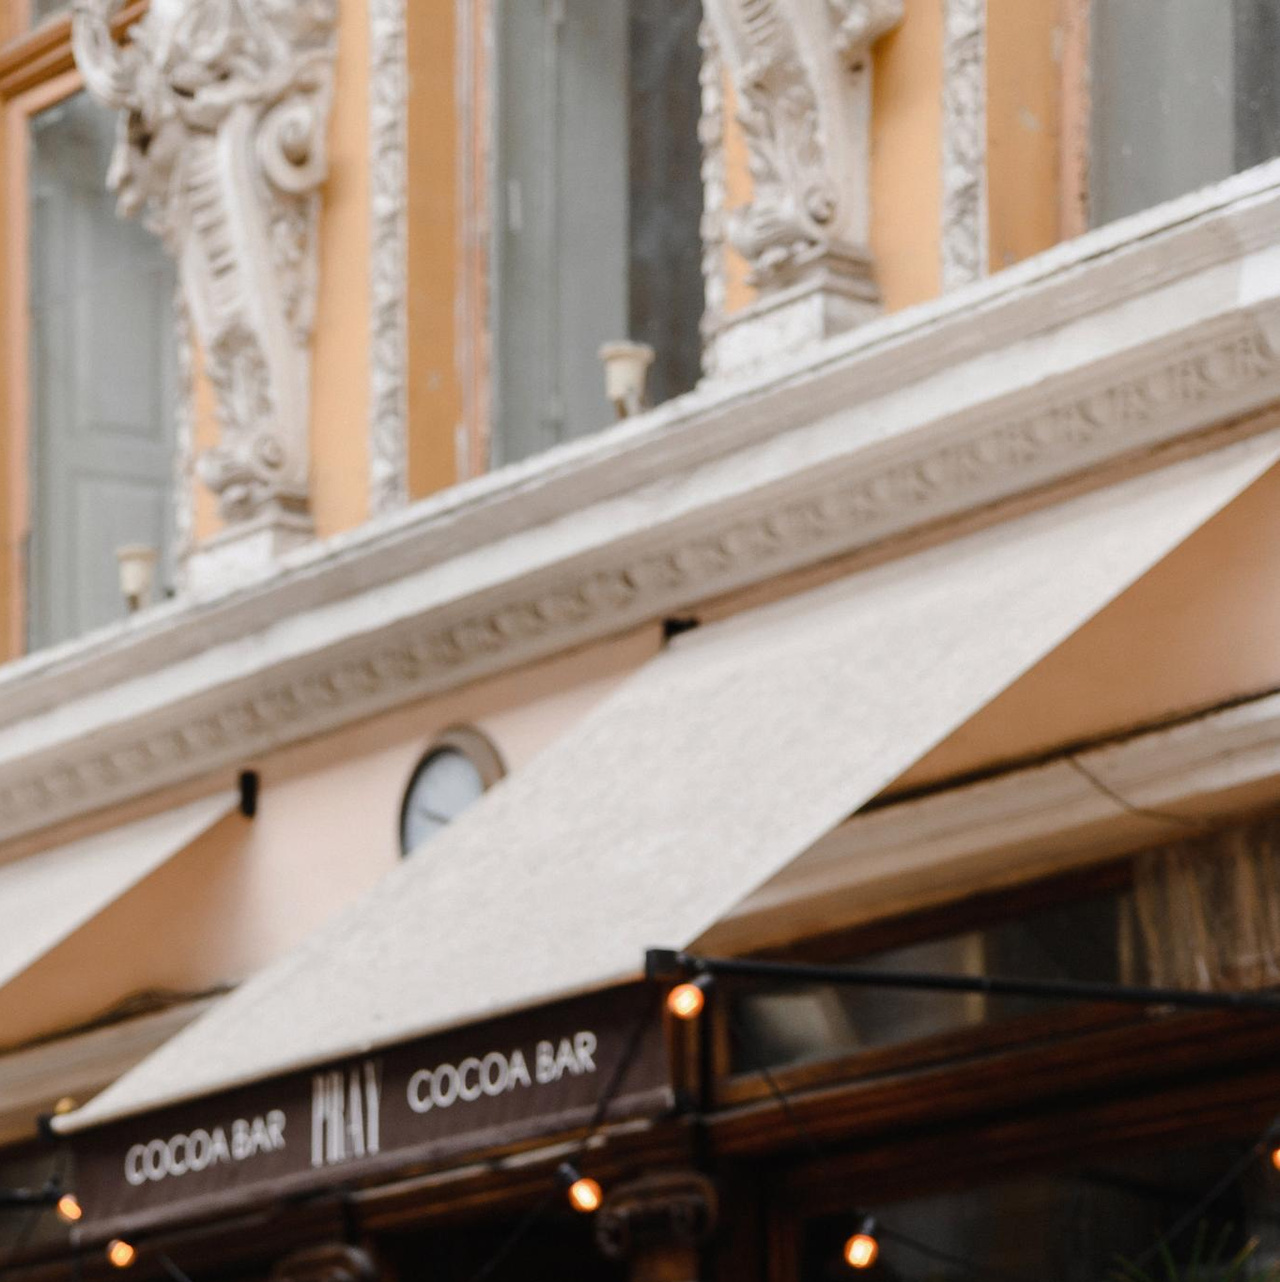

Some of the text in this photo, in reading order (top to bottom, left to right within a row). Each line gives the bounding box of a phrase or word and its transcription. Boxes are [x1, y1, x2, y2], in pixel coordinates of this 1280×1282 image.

[124, 1127, 231, 1186] COCOA
[231, 1109, 287, 1161] BAR
[406, 1049, 532, 1114] COCOA
[535, 1031, 597, 1084] BAR
